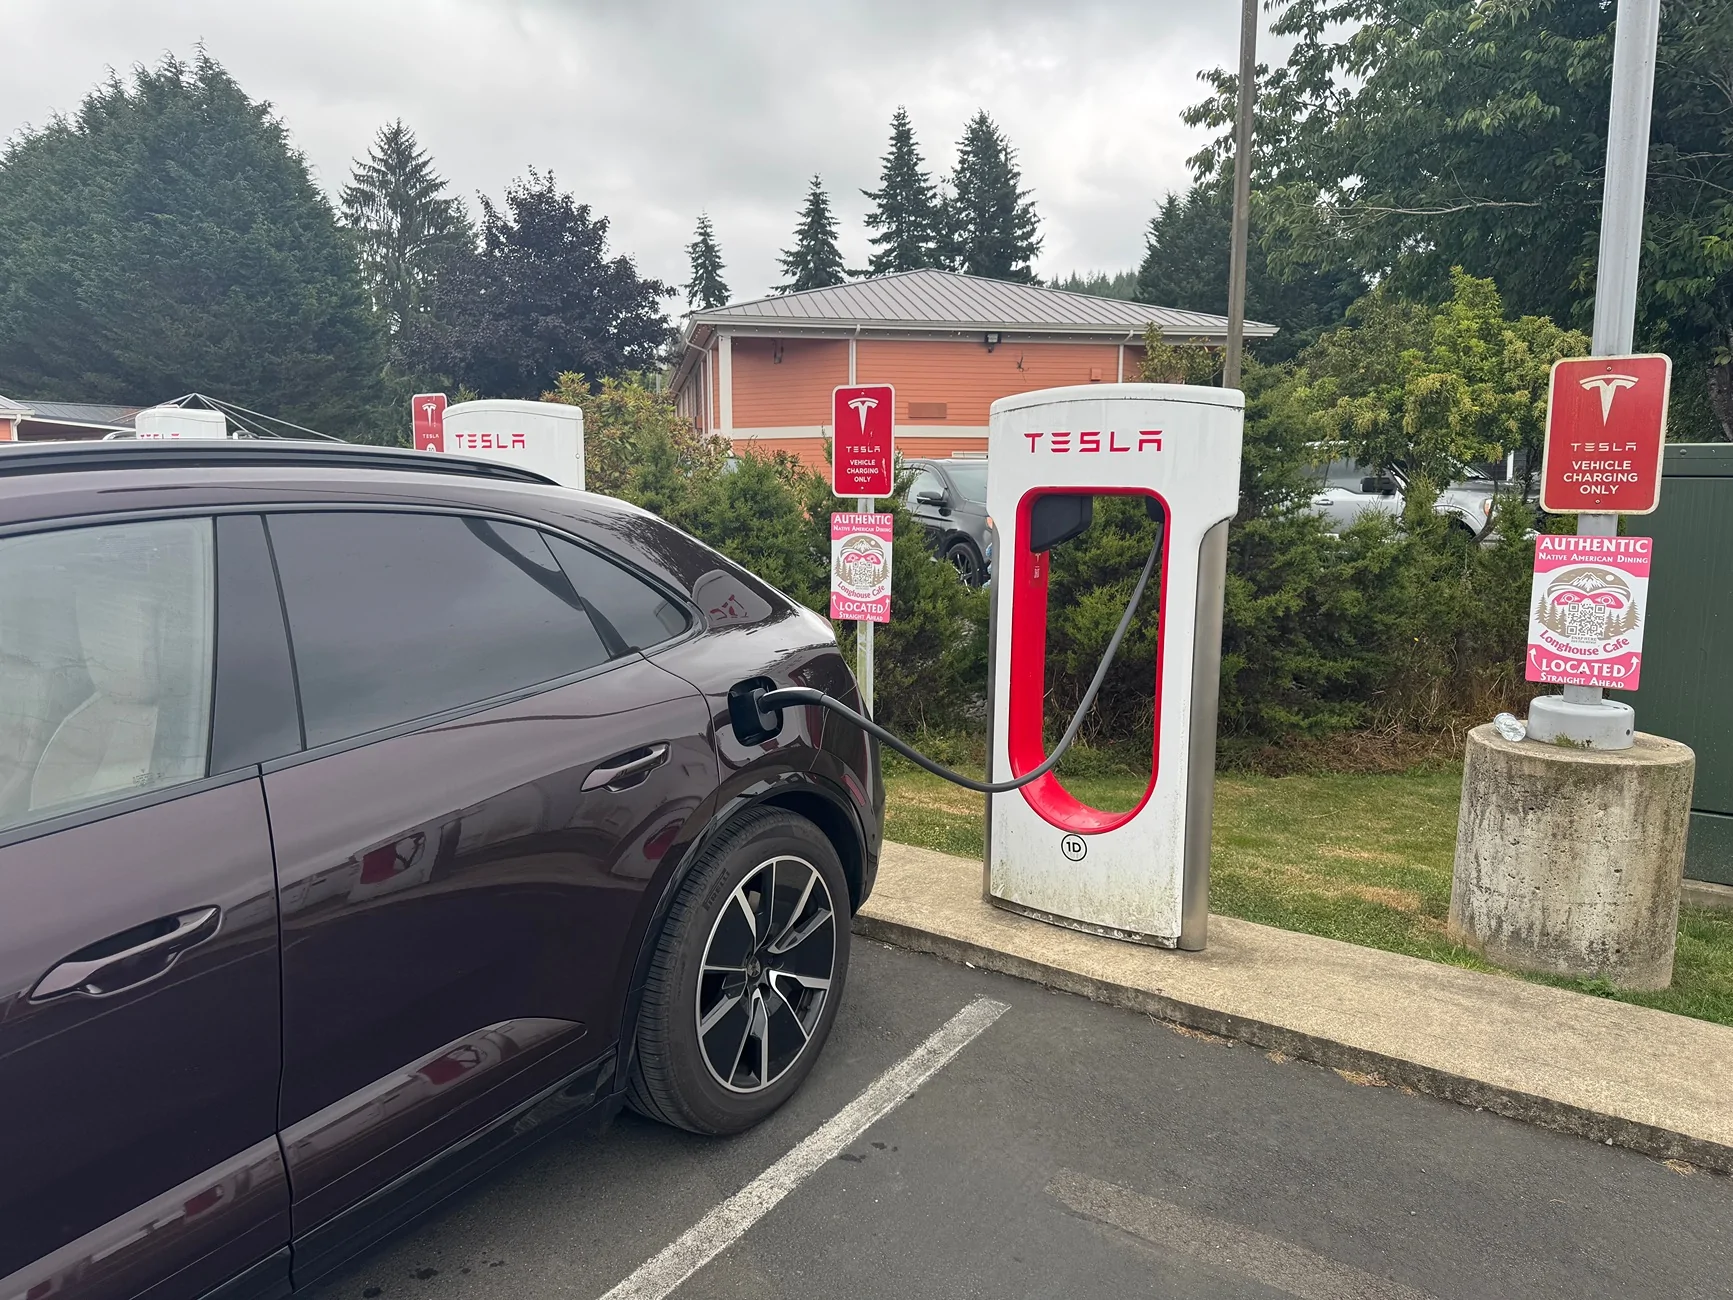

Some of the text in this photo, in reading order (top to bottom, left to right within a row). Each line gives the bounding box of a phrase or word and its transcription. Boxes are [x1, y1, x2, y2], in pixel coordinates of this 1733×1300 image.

[455, 433, 525, 449] TESLA
[1023, 430, 1163, 453] TESLA
[1570, 442, 1637, 452] TESLA
[845, 445, 881, 453] TESLA
[1572, 460, 1632, 470] VEHICLE
[1563, 472, 1638, 482] CHARGING
[1580, 485, 1619, 495] ONLY
[834, 514, 891, 525] AUTHENTIC
[1539, 537, 1648, 553] AUTHENTIC
[837, 580, 886, 599] Longhouse Cafe
[840, 601, 883, 614] LOCATED
[1539, 629, 1630, 656] Longhouse Cafe
[1541, 658, 1626, 677] LOCATED
[1066, 841, 1082, 853] 1D
